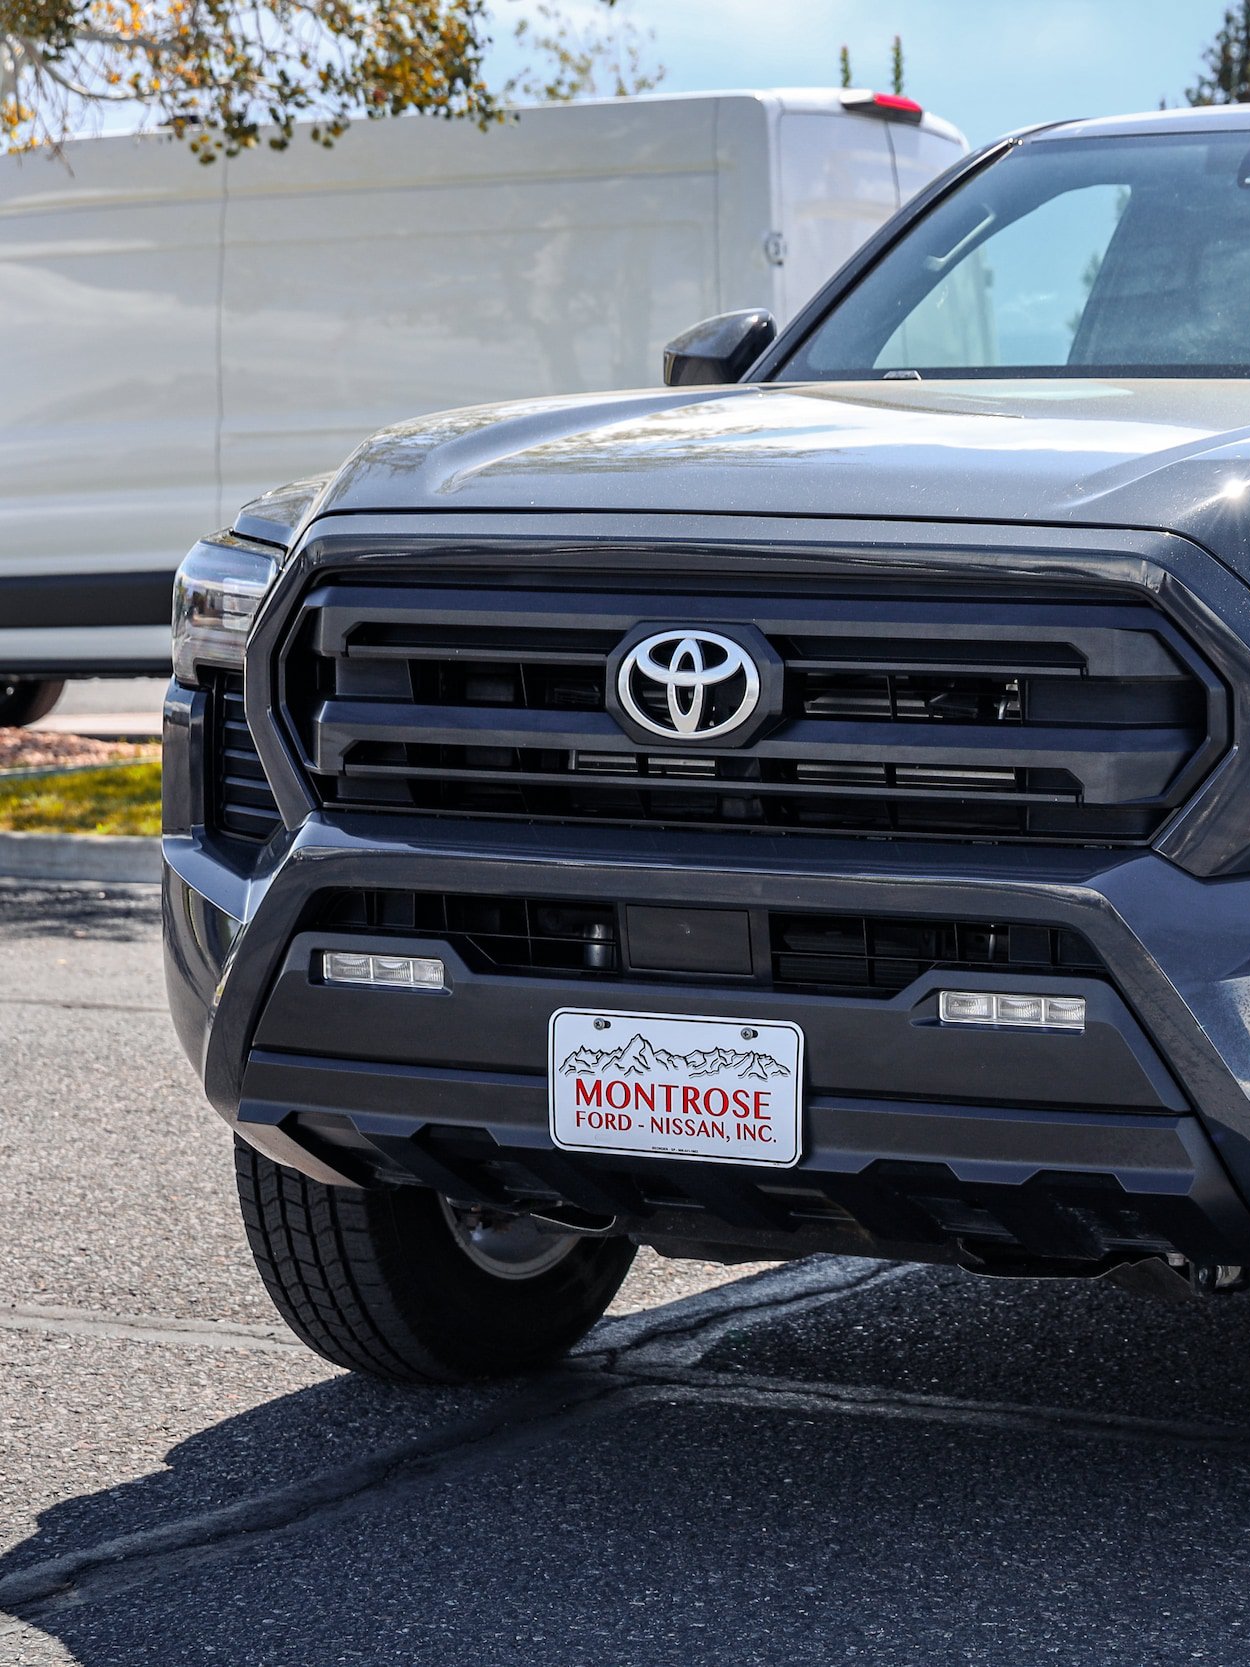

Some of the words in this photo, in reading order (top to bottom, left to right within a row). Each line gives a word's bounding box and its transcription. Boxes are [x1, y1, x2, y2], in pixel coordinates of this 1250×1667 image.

[575, 1078, 772, 1121] MONTROSE
[575, 1110, 633, 1131] FORD
[650, 1116, 731, 1143] NISSAN,
[736, 1122, 778, 1144] INC.
